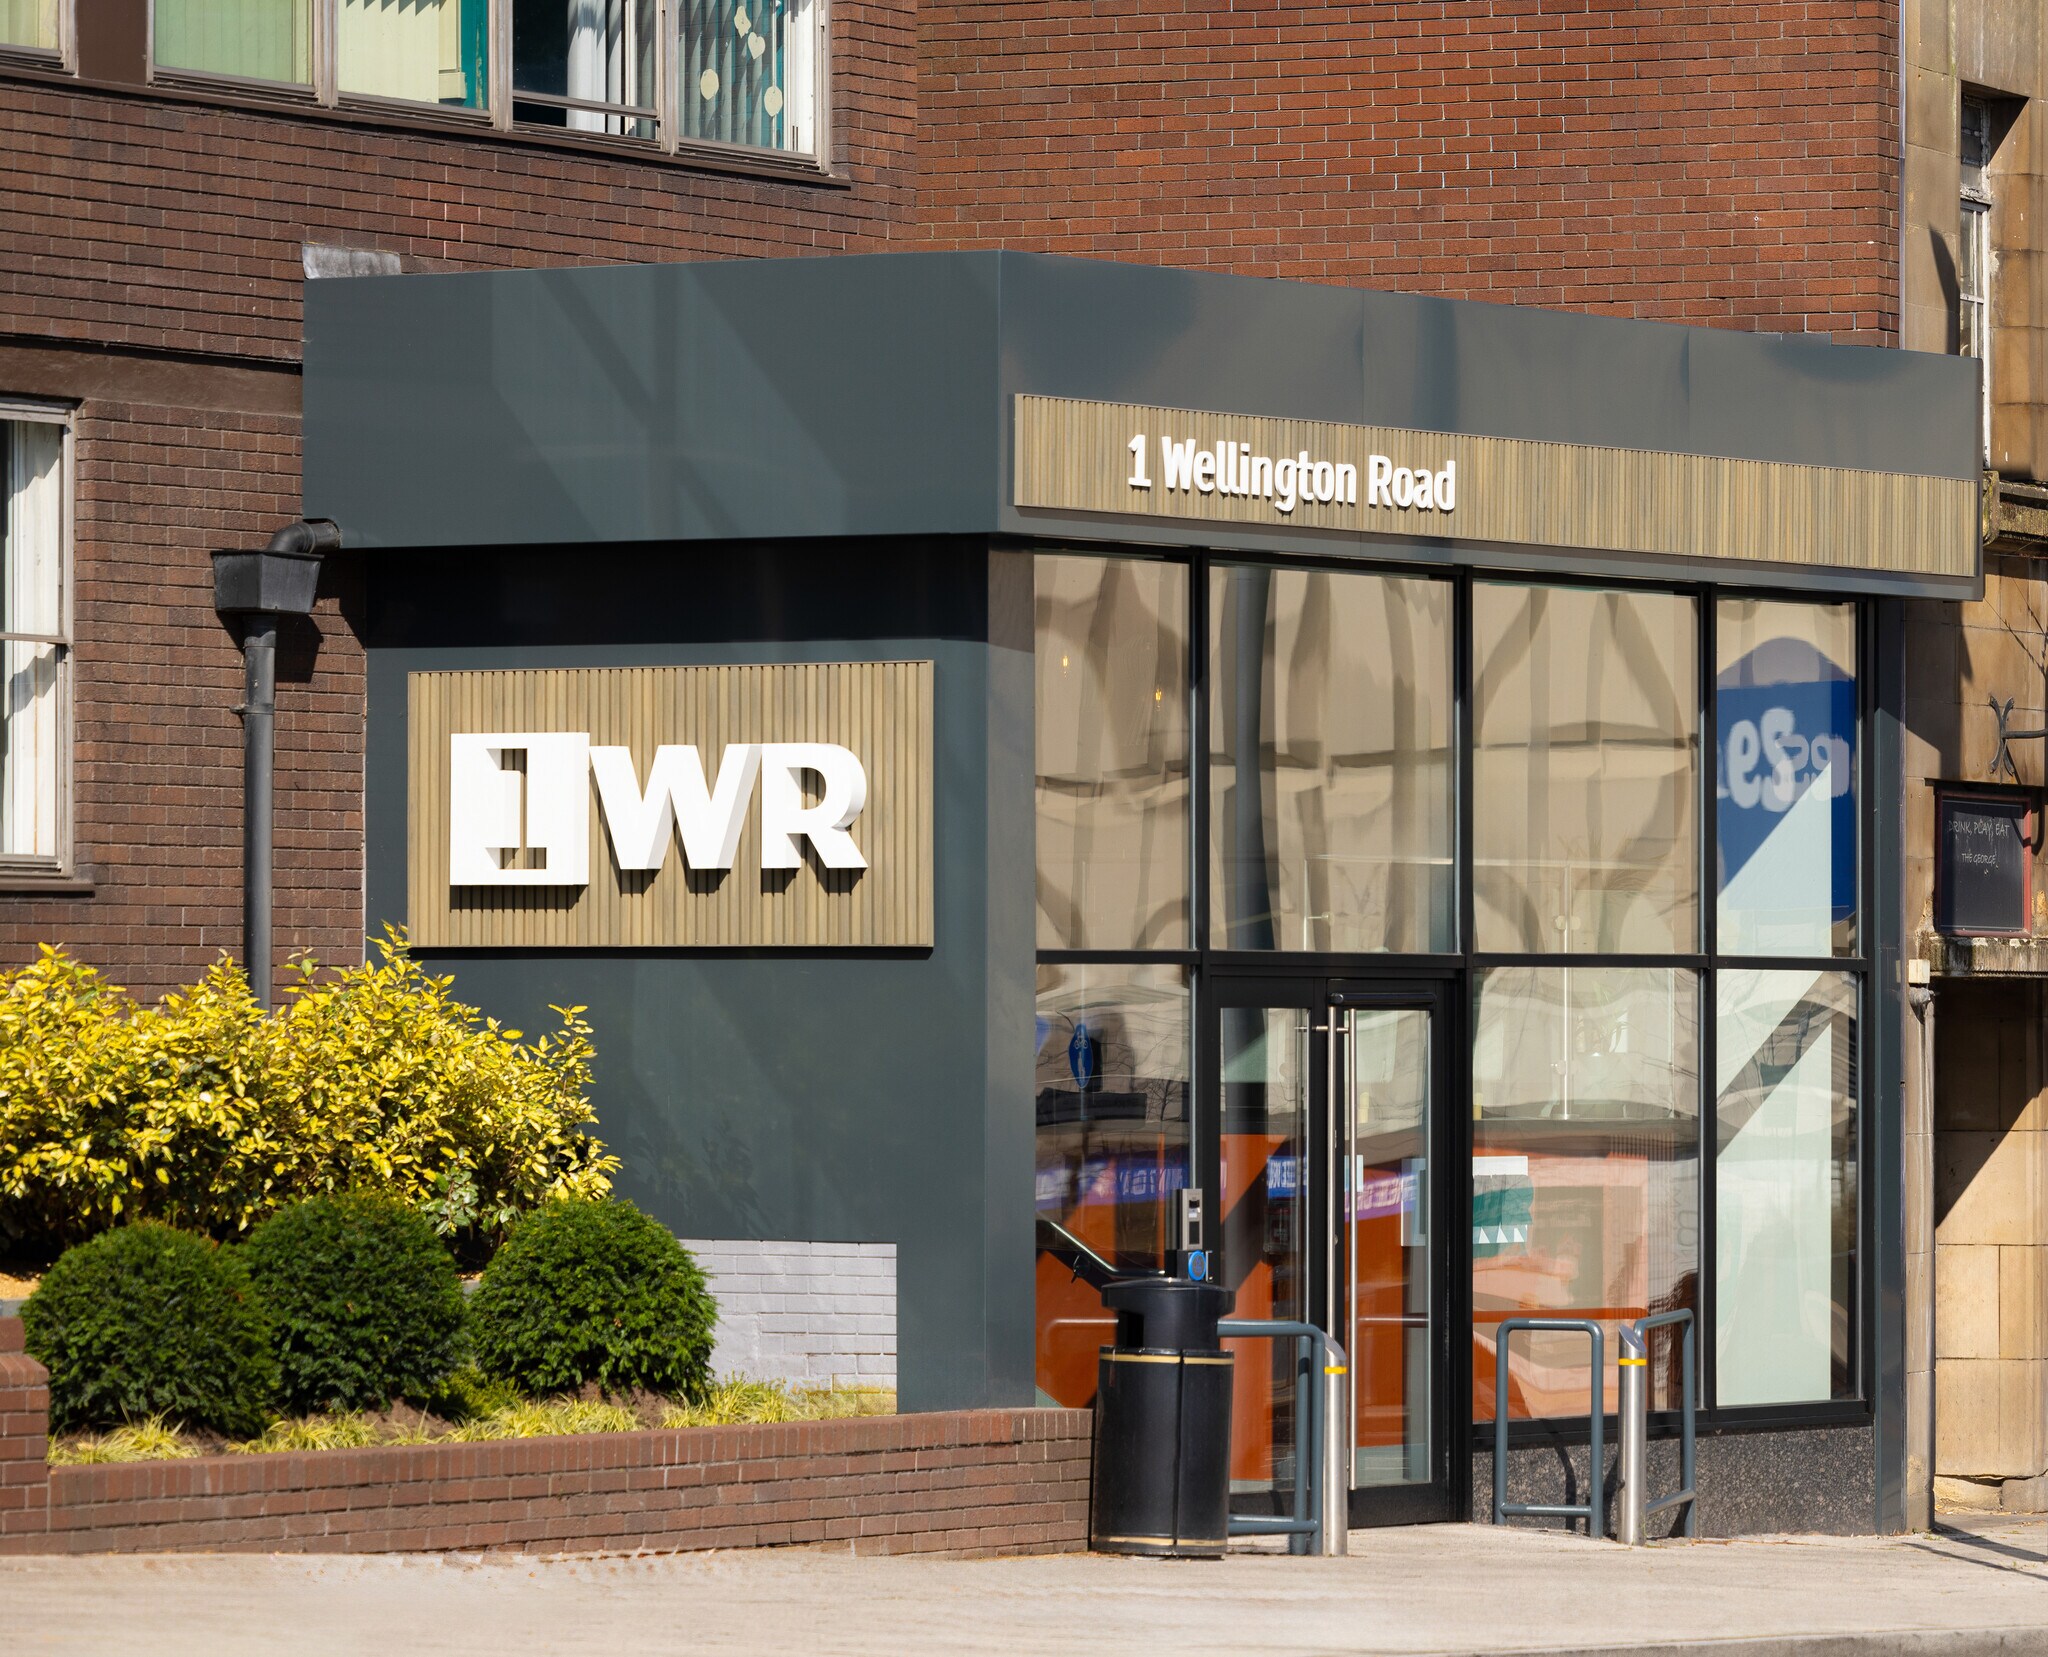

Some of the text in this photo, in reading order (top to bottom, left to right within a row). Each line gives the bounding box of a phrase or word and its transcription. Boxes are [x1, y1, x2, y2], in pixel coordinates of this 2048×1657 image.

[1128, 434, 1456, 512] 1 Wellington Road
[1995, 824, 2010, 837] EAT
[1961, 853, 1996, 866] THE GEORGE
